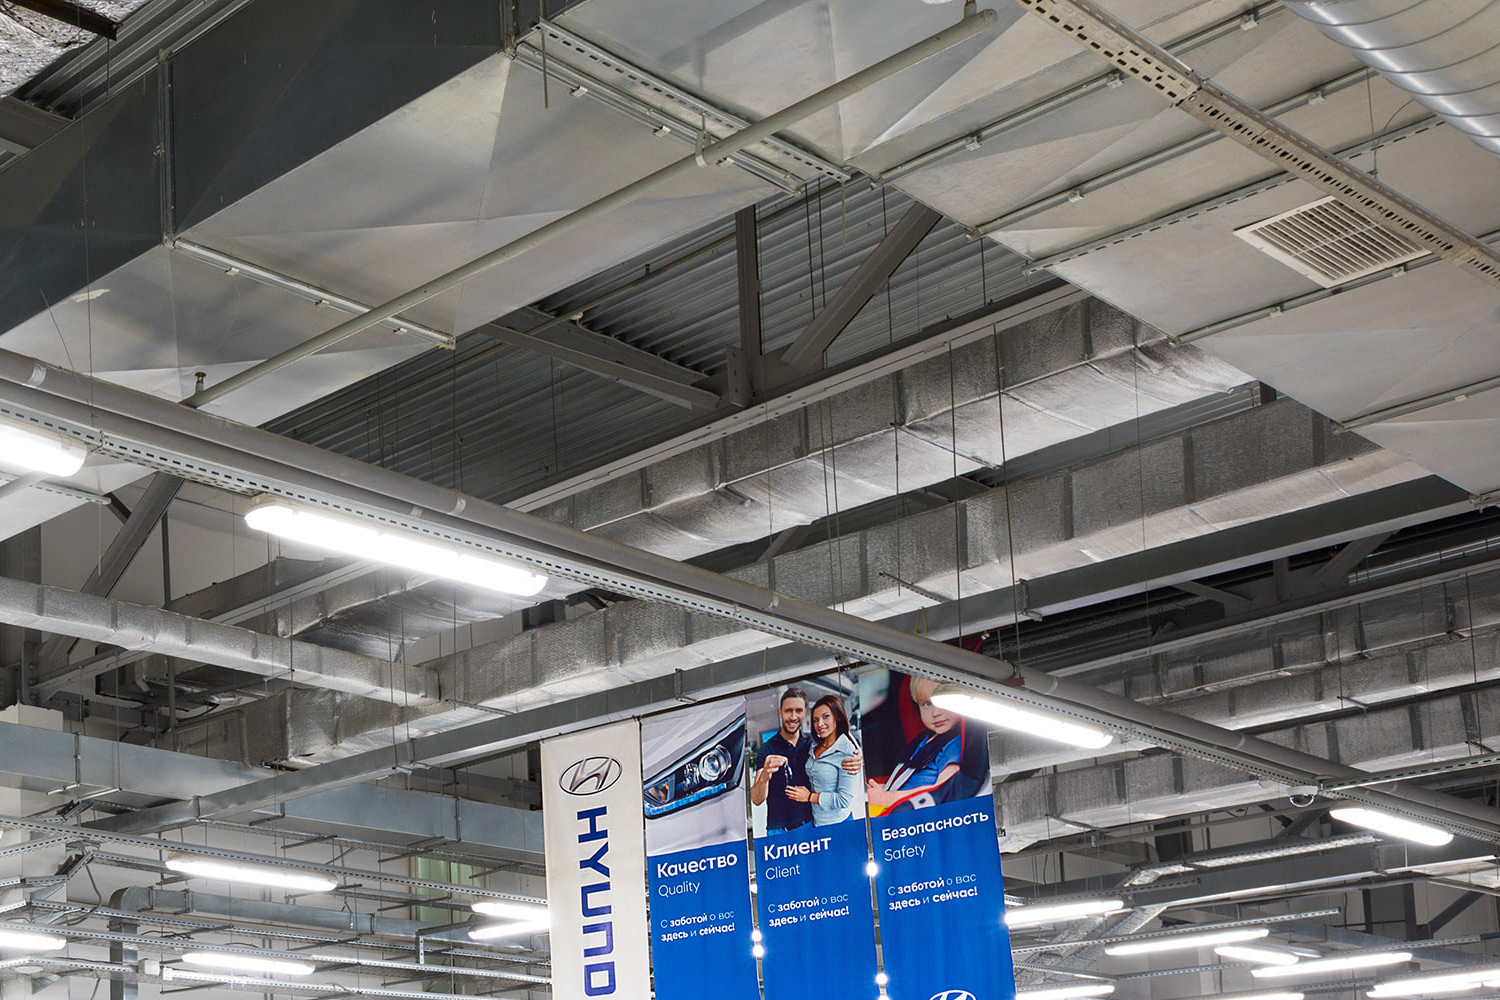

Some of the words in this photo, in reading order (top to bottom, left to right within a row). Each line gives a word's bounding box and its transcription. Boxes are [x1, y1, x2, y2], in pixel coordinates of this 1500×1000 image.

[881, 812, 989, 841] Безопасность
[763, 837, 832, 861] Клиент
[884, 844, 926, 862] Safety
[657, 853, 738, 879] Качество
[765, 864, 801, 880] Client
[658, 880, 700, 898] Quality
[887, 886, 896, 896] С
[897, 877, 945, 895] заботой
[946, 877, 953, 886] о
[955, 873, 977, 885] вас
[767, 903, 776, 914] С
[777, 896, 820, 912] заботой
[820, 897, 828, 905] о
[830, 893, 849, 904] вас
[888, 898, 921, 911] здесь
[932, 886, 978, 903] сейчас!
[660, 919, 669, 929] С
[669, 912, 708, 928] заботой
[708, 913, 716, 921] о
[768, 915, 798, 928] здесь
[809, 905, 850, 921] сейчас!
[661, 932, 689, 942] здесь
[699, 922, 736, 936] сейчас!
